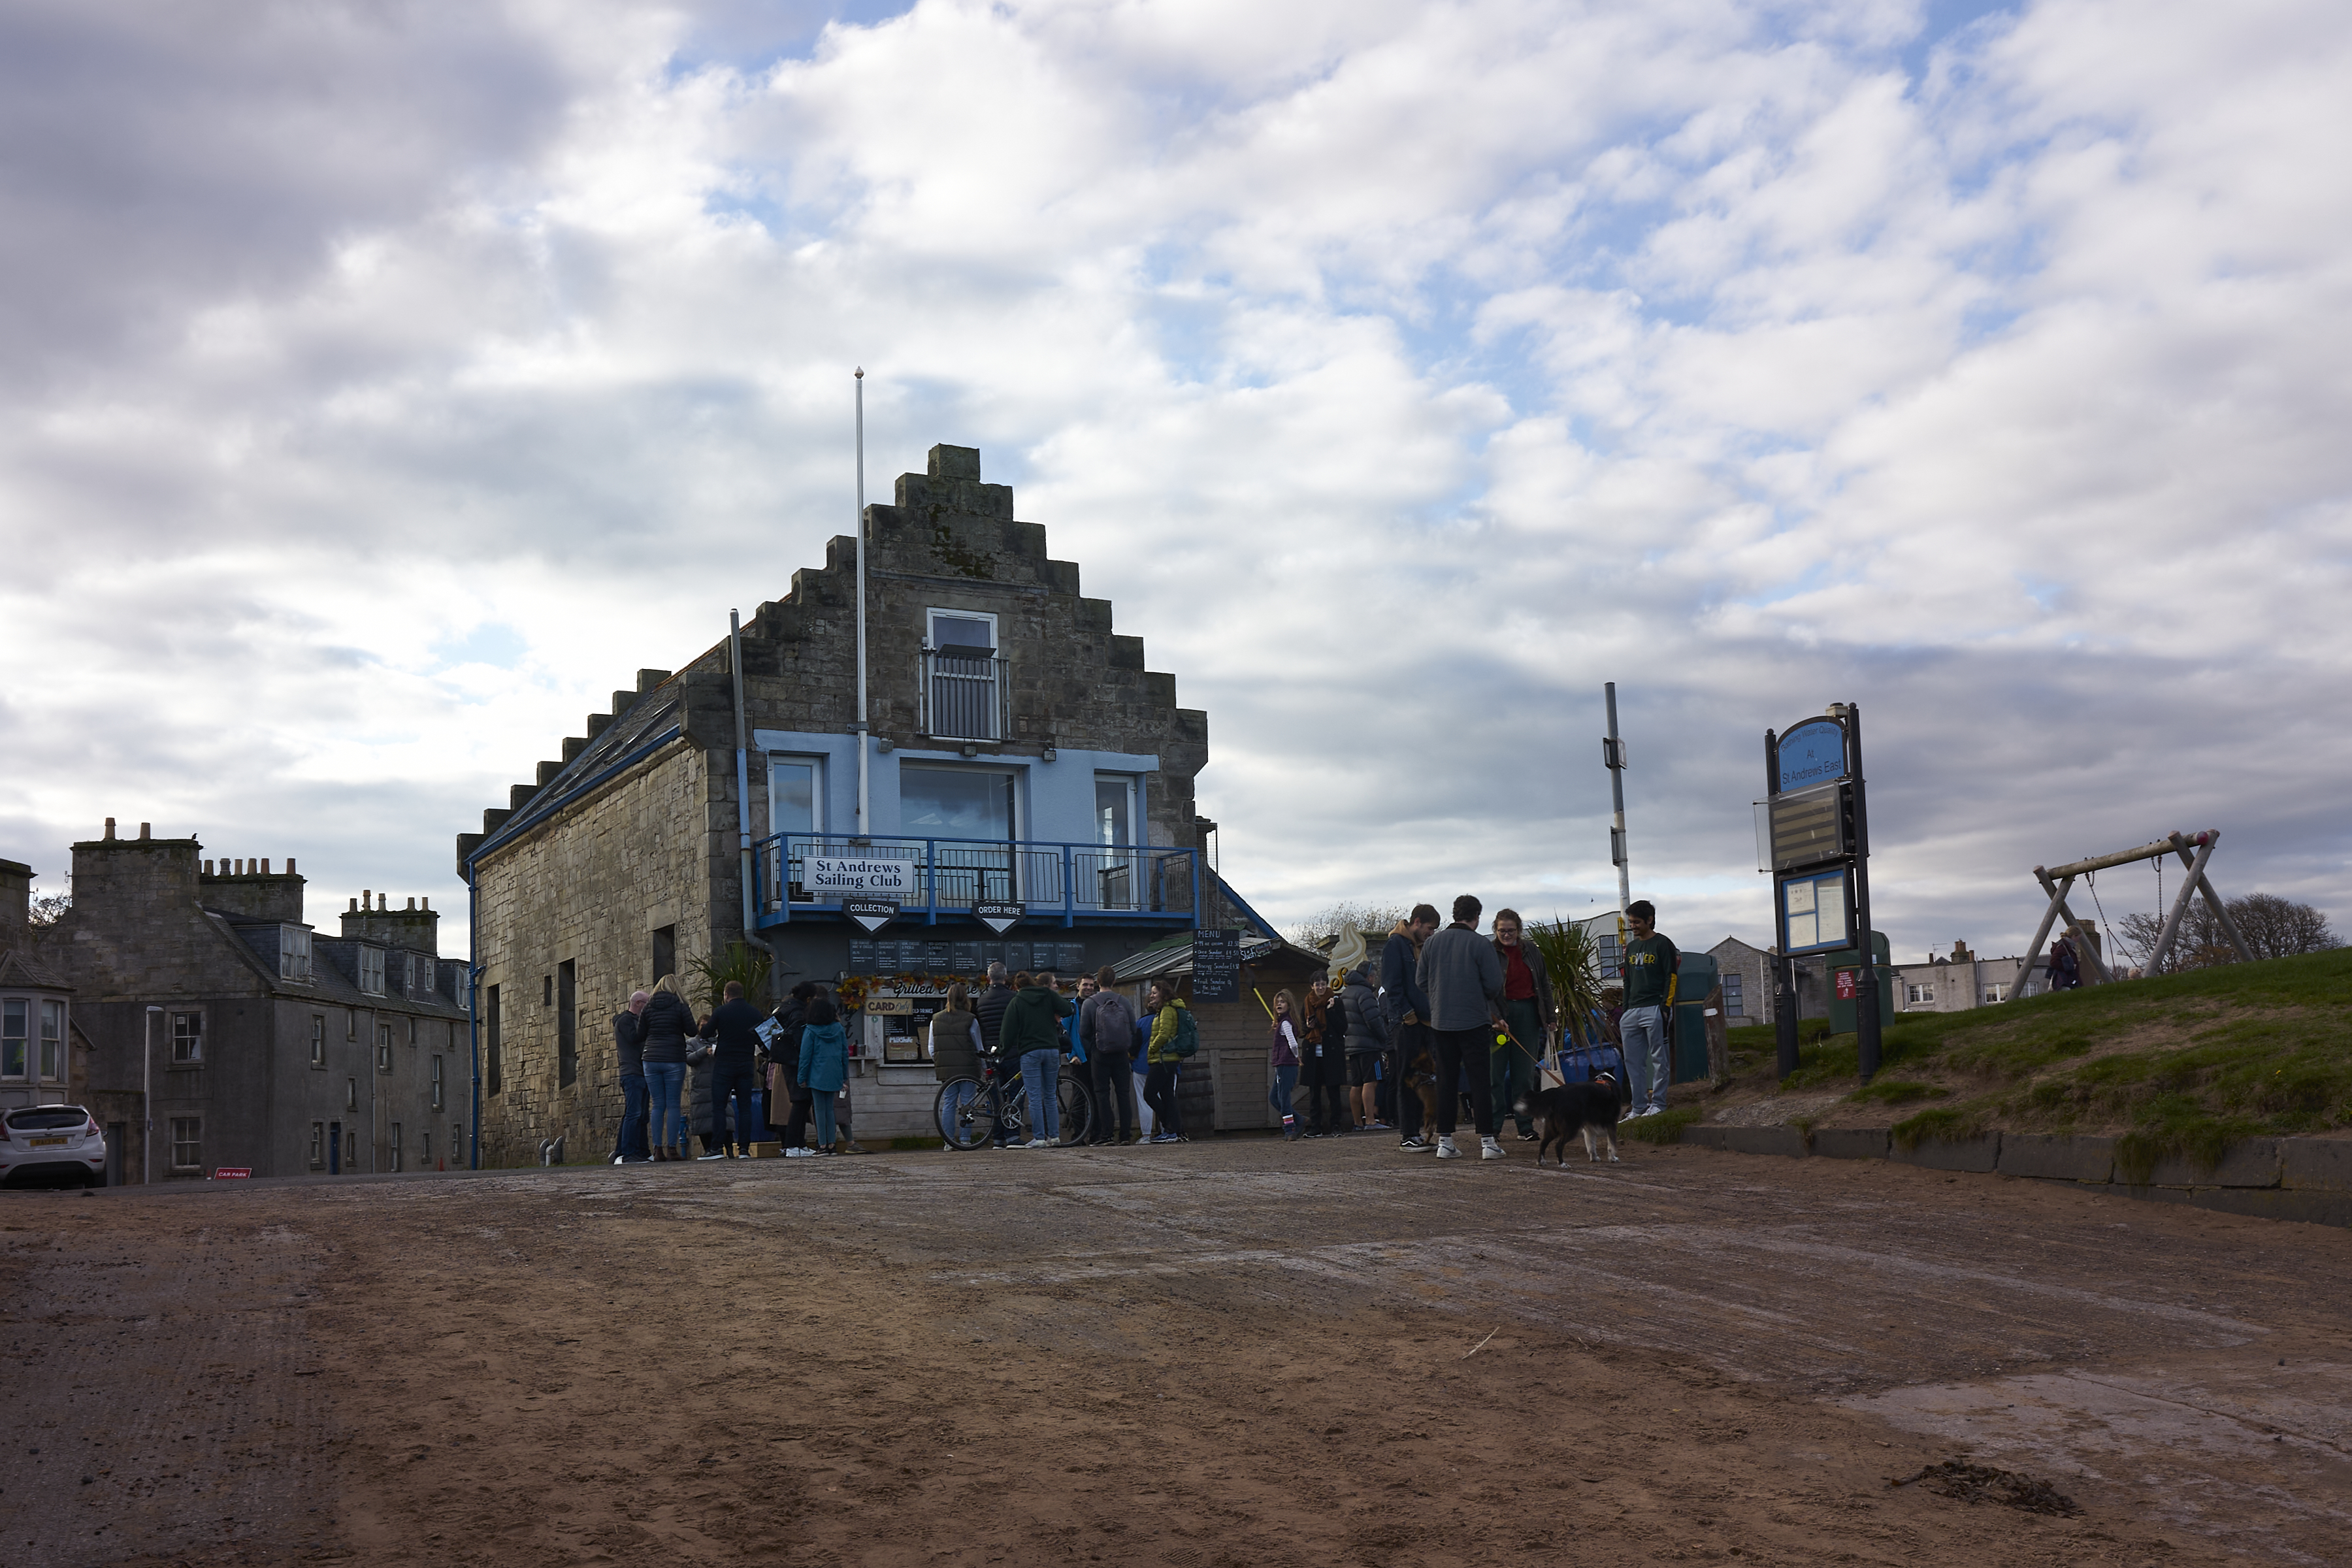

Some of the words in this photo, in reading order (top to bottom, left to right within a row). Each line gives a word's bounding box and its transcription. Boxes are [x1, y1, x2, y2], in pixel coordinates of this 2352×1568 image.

[1781, 734, 1801, 752] Bathing
[1801, 728, 1818, 738] Water
[1819, 725, 1839, 738] Quality
[1807, 749, 1814, 759] At
[1782, 772, 1790, 785] St
[1791, 766, 1823, 782] Andrews
[1824, 759, 1842, 773] East
[817, 860, 832, 872] St
[837, 861, 901, 874] Andrews
[815, 874, 864, 889] Sailing
[870, 875, 902, 887] Club
[850, 904, 894, 915] COLLECTION
[978, 906, 1002, 915] ORDER
[1003, 907, 1021, 915] HERE
[1241, 948, 1257, 960] Slush
[894, 981, 935, 998] Grilled
[868, 1002, 895, 1011] CARD
[895, 1000, 910, 1013] Only
